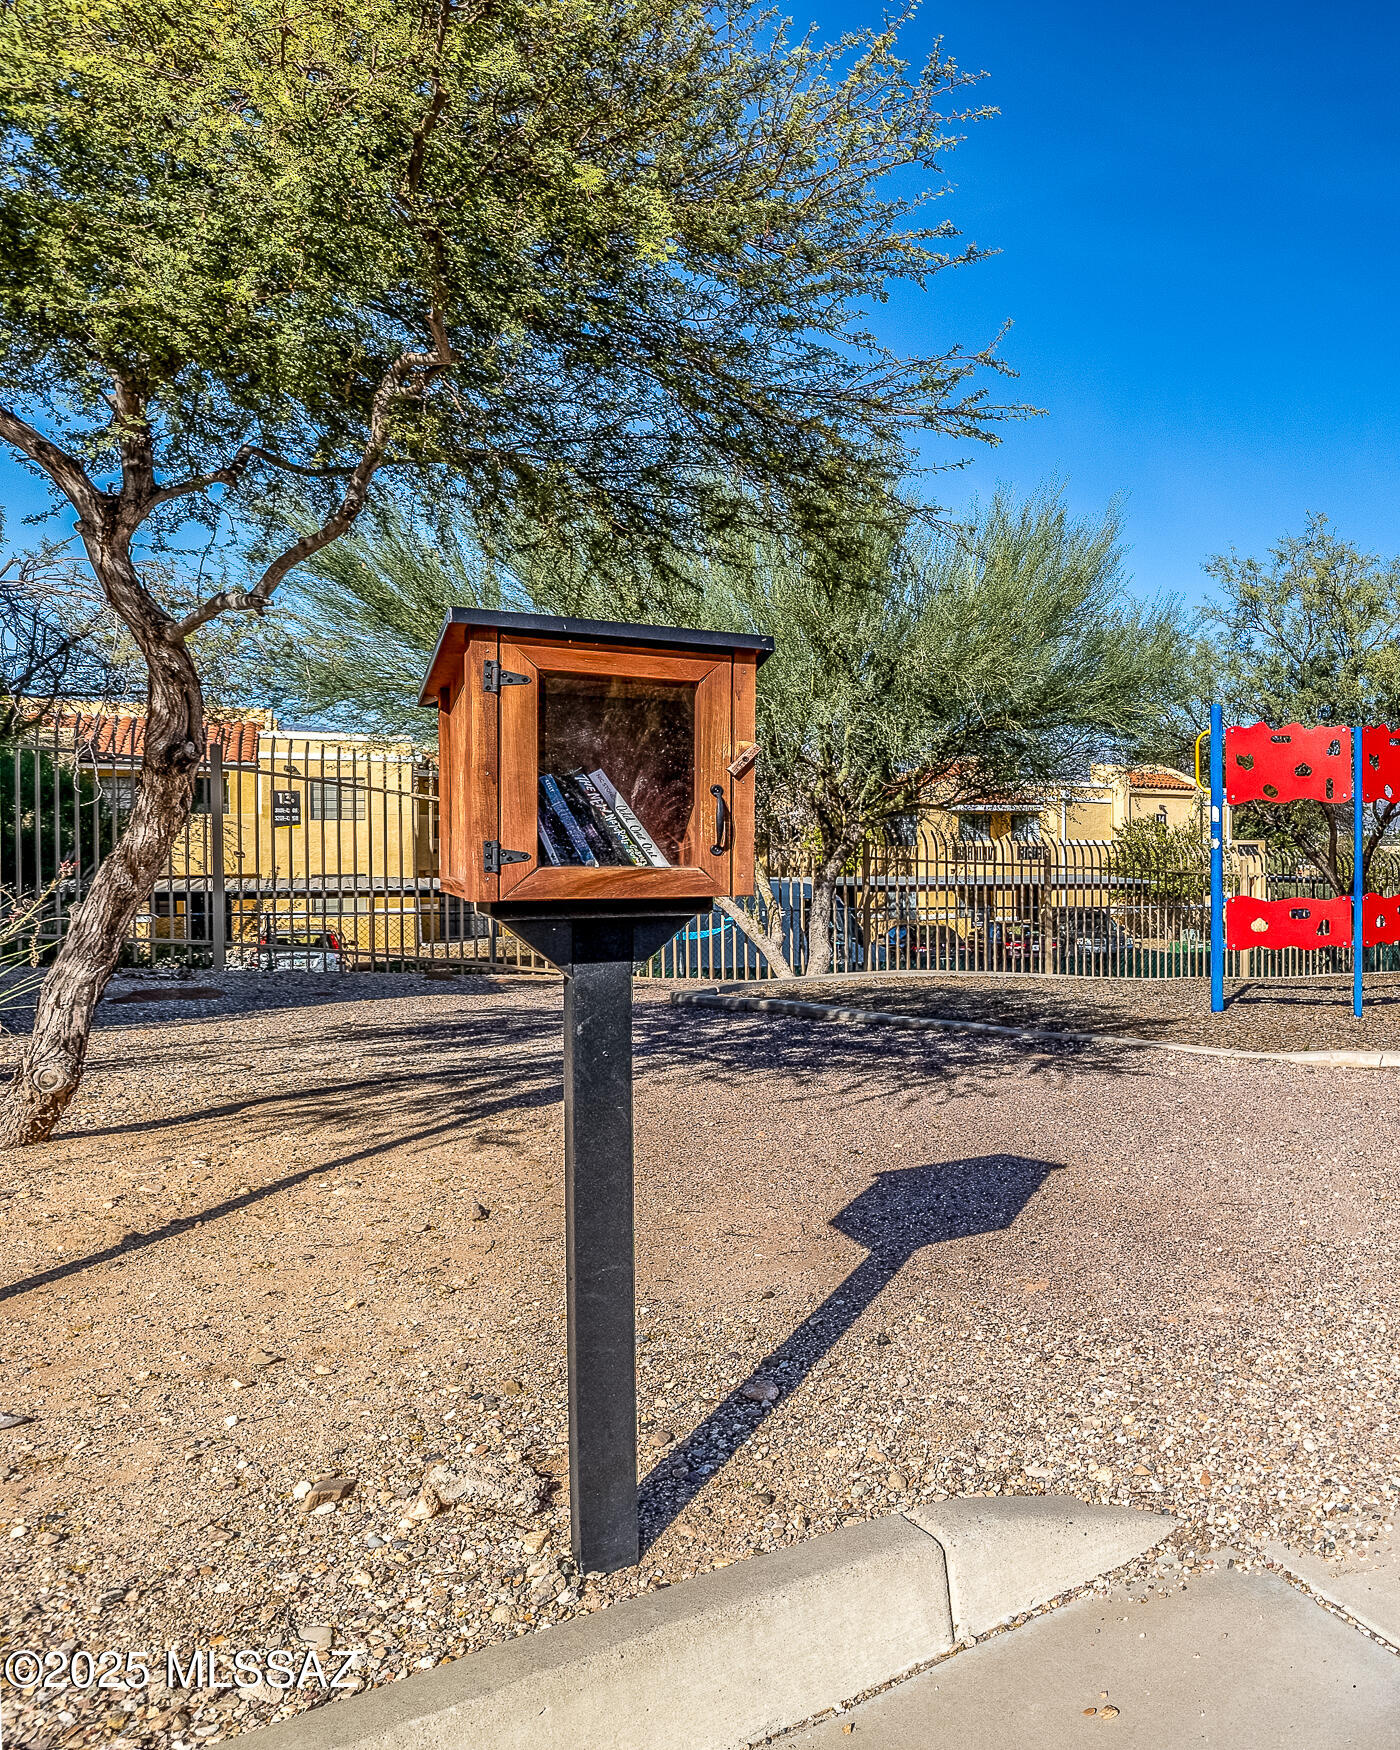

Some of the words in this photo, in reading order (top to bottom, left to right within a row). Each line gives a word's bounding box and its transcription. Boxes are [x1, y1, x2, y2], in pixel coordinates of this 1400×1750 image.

[574, 773, 597, 792] THE
[587, 792, 613, 813] NEW
[629, 825, 647, 841] One
[641, 843, 658, 858] Out
